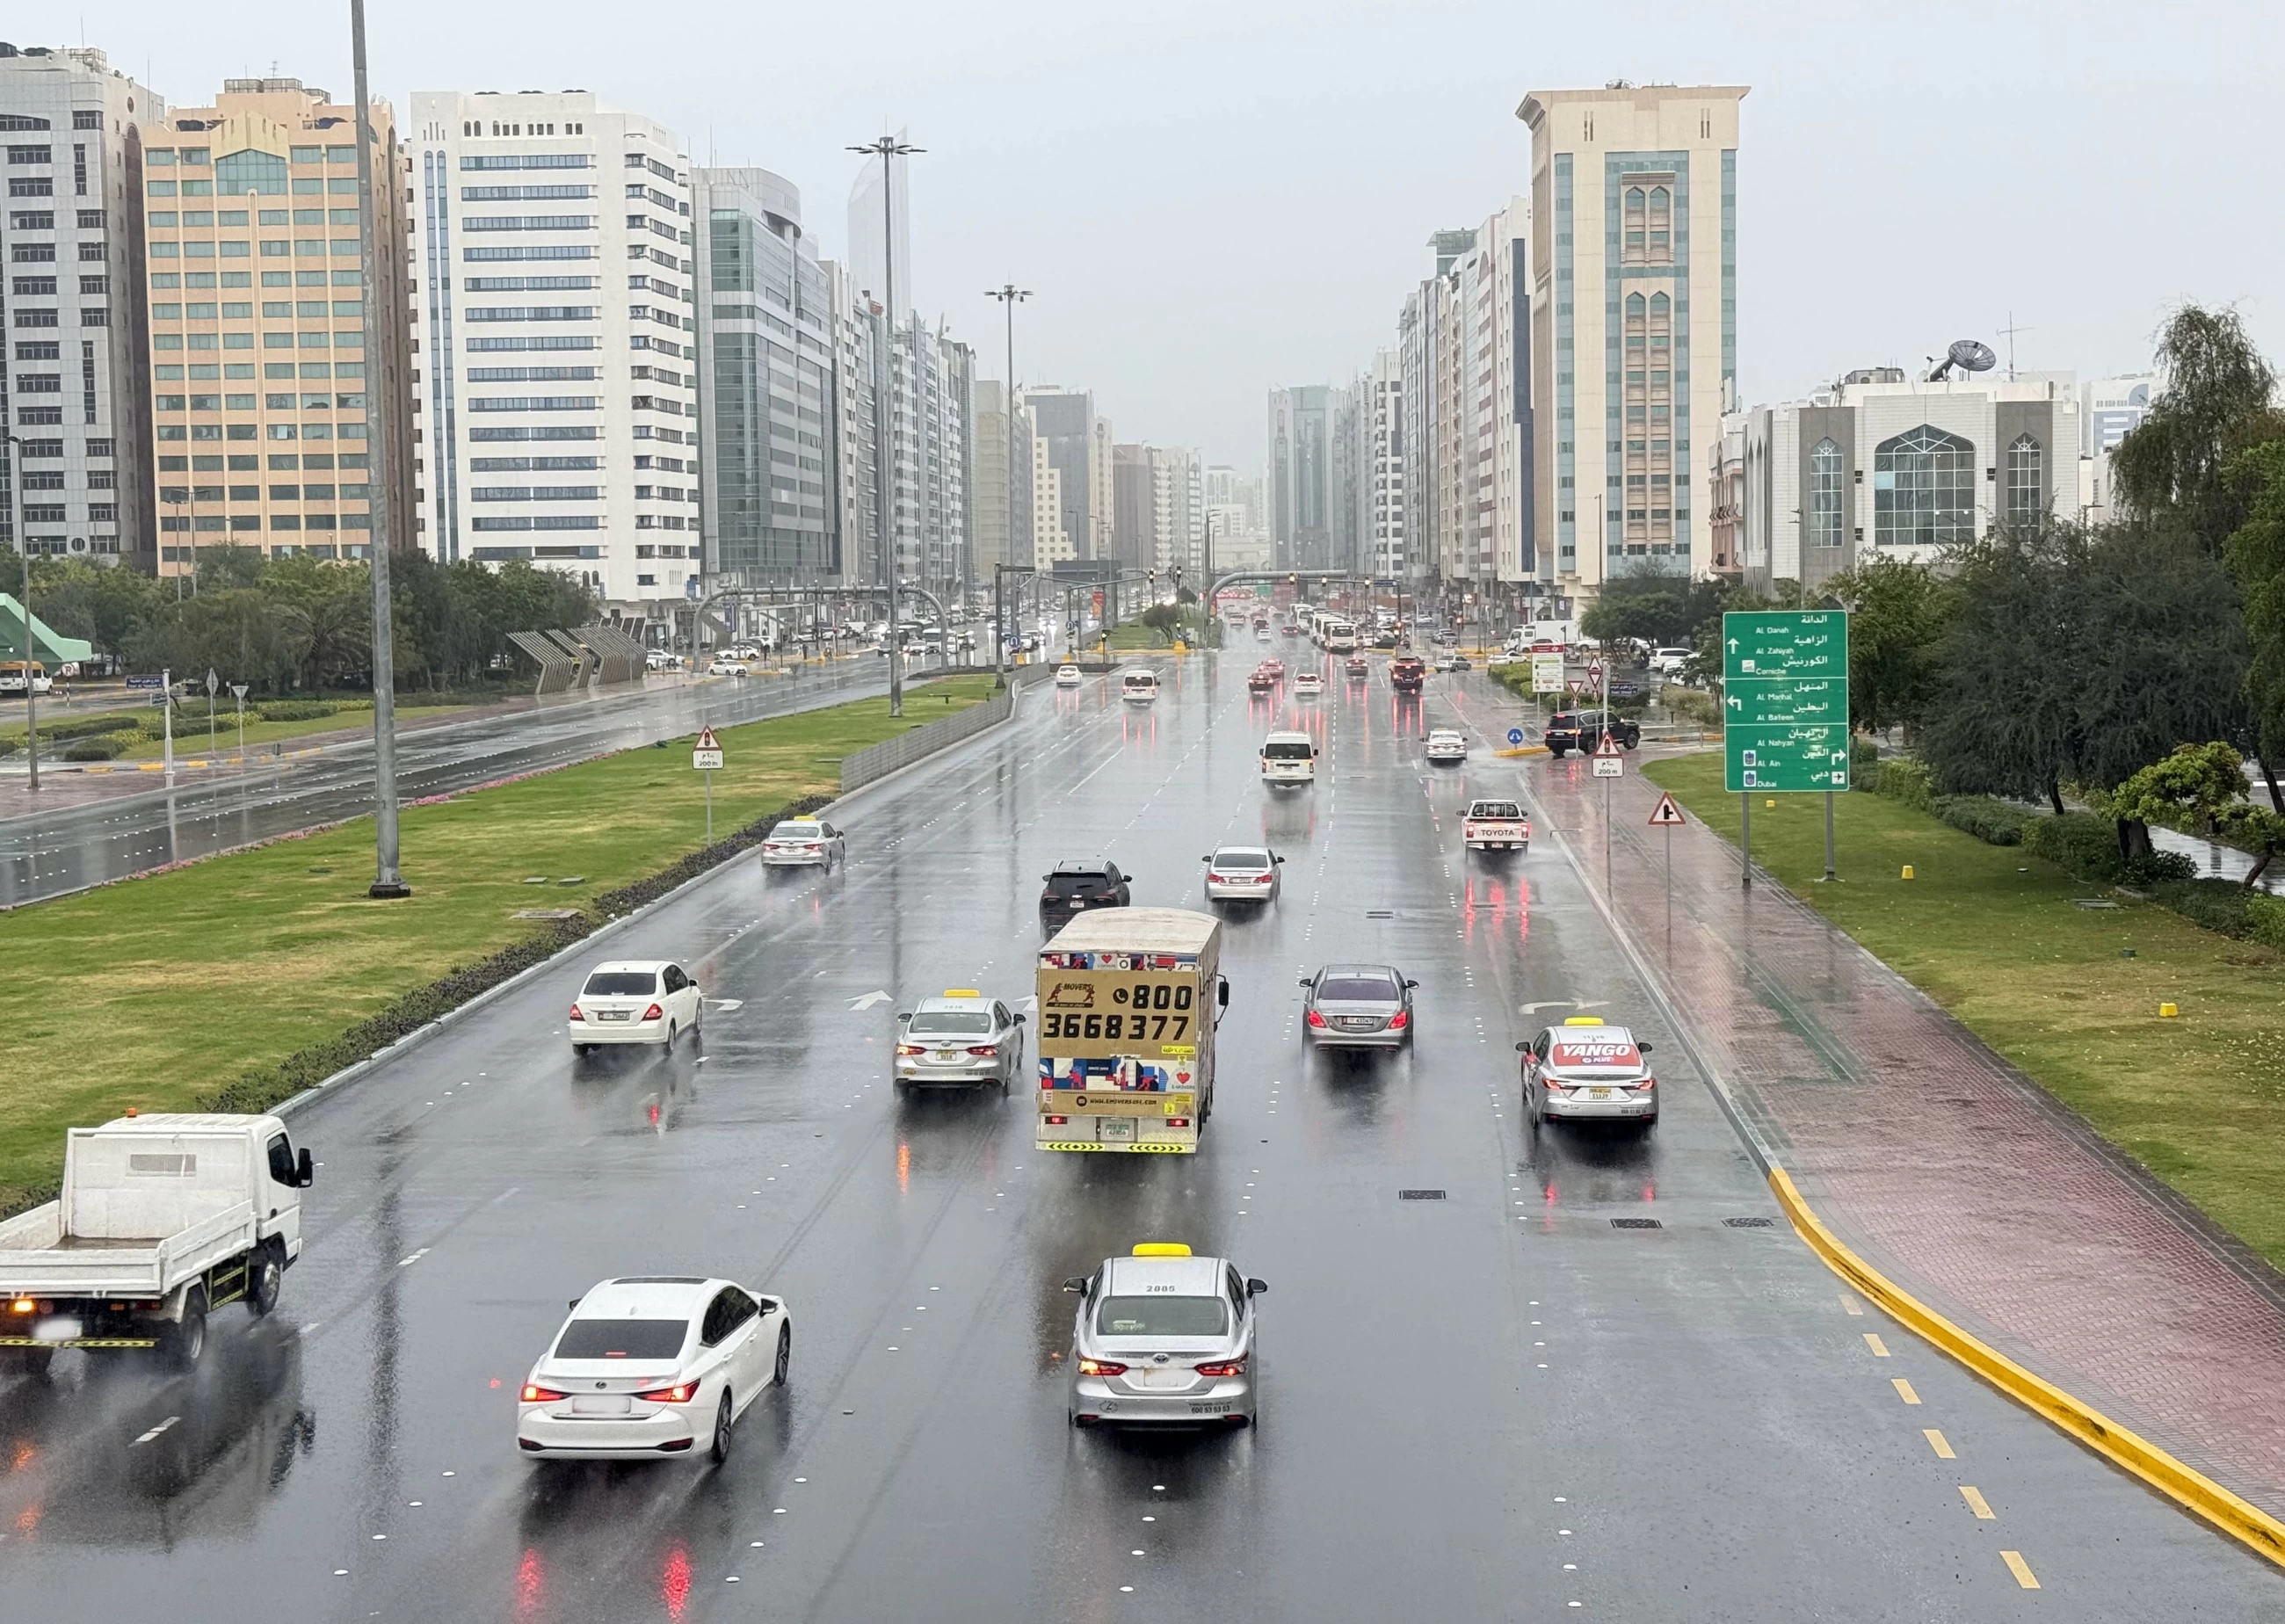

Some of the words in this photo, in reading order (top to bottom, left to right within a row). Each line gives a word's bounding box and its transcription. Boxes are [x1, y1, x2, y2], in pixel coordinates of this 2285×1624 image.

[1794, 634, 1828, 646] الزاهية
[1766, 647, 1795, 656] Zahiyah
[1782, 655, 1828, 667] الكورنيش
[1794, 681, 1828, 692] المنهل
[1793, 701, 1828, 713] البطين
[1768, 739, 1795, 748] Nahyan
[1810, 770, 1830, 783] دبي
[1132, 984, 1193, 1010] 800
[1561, 1044, 1631, 1057] YANGO
